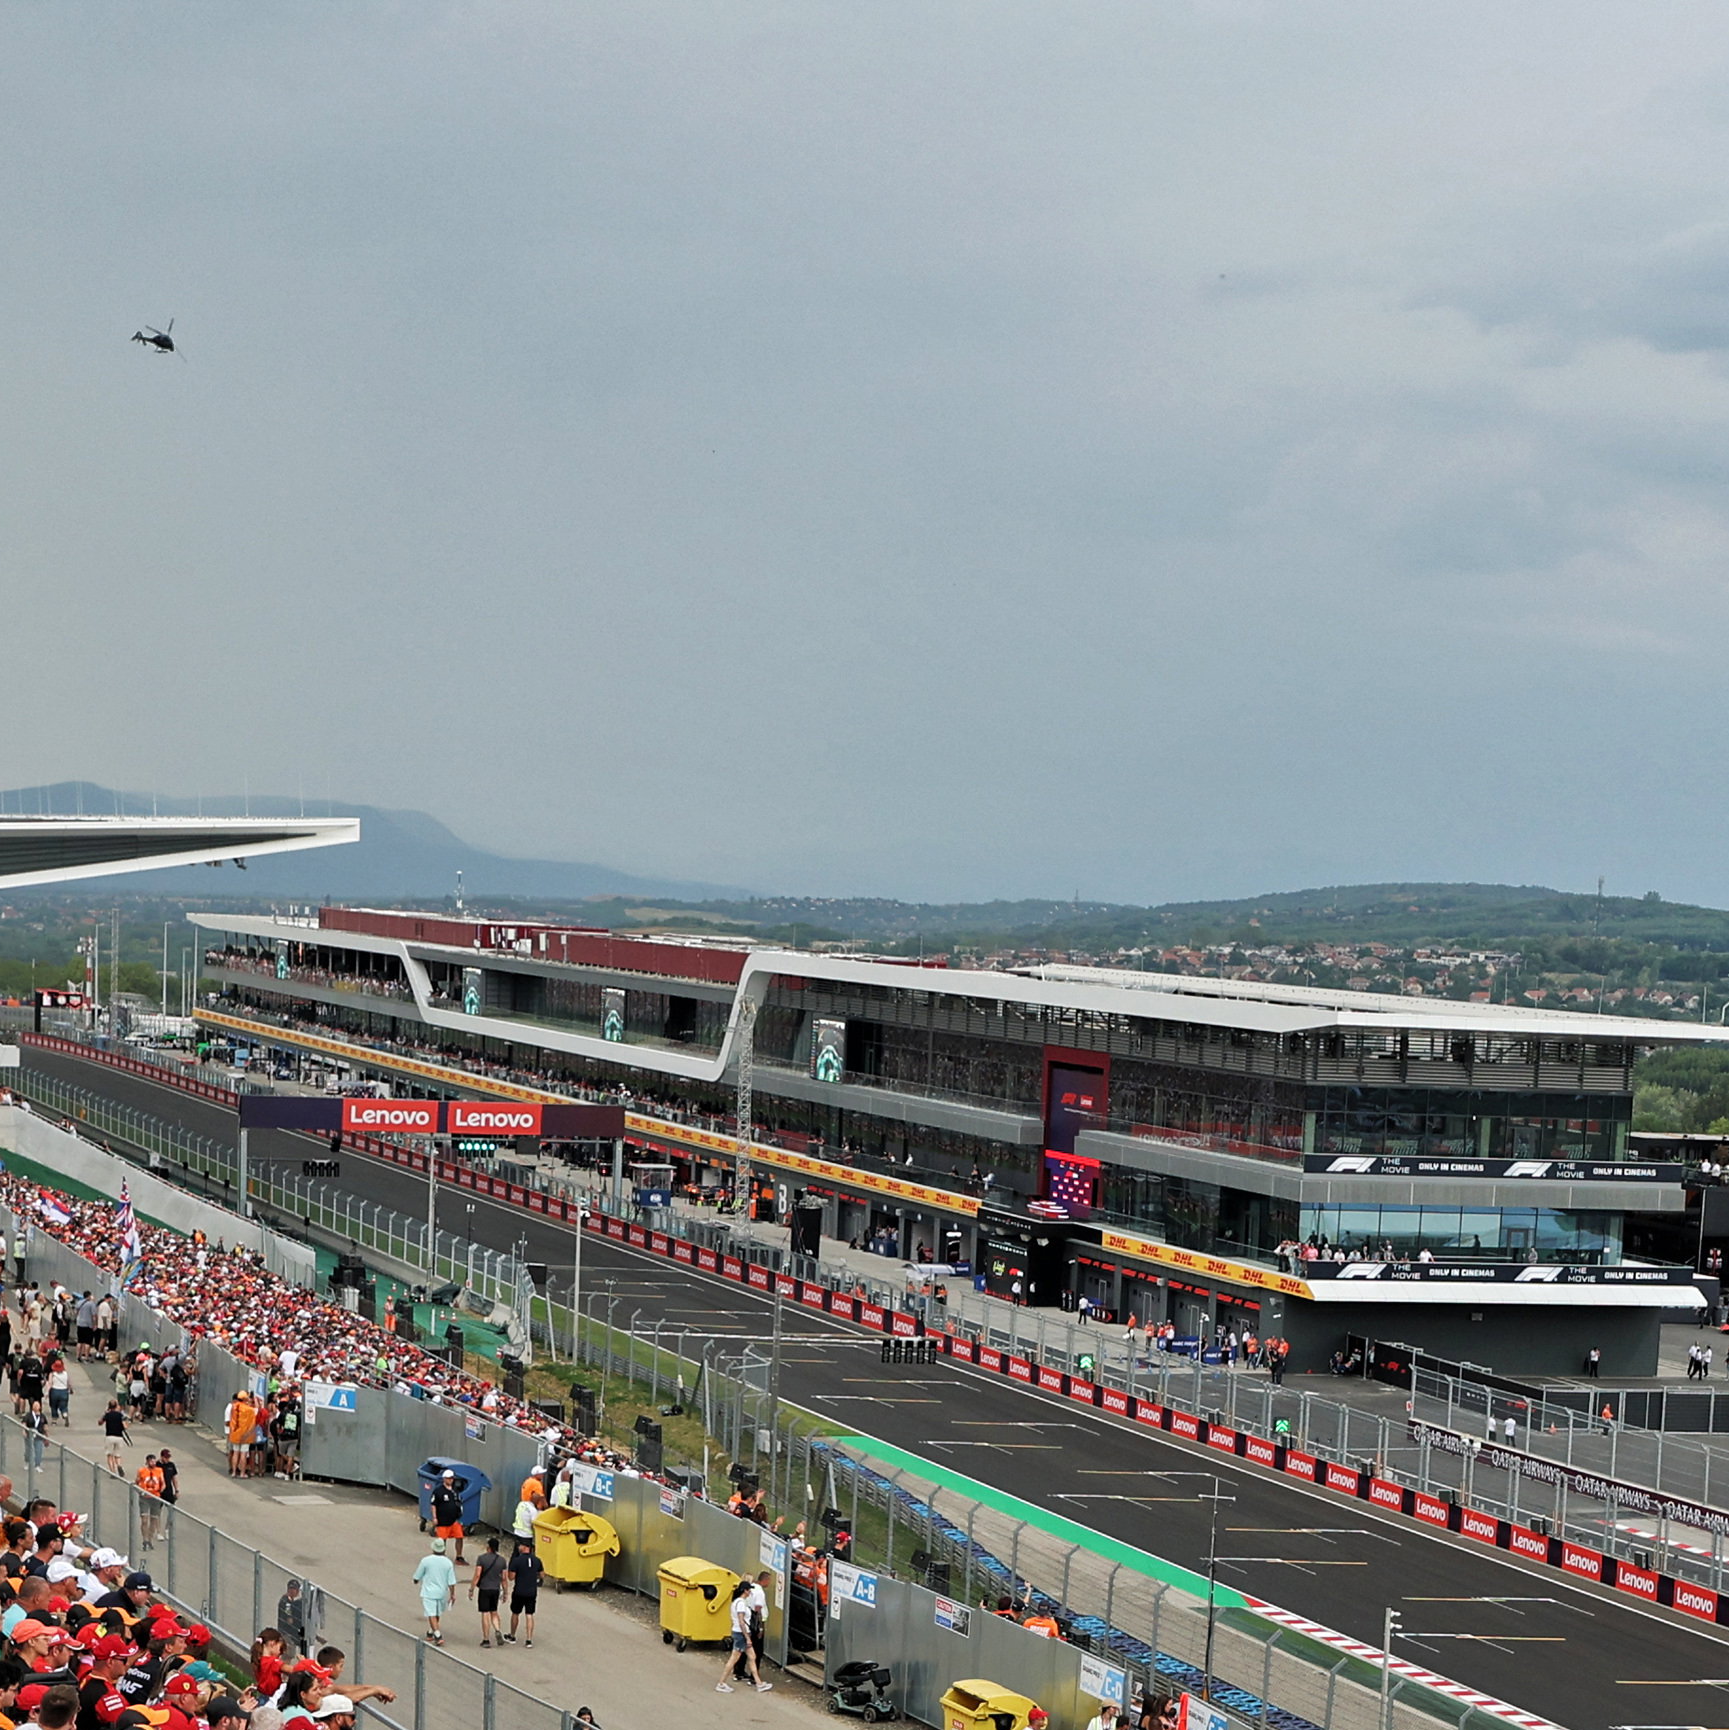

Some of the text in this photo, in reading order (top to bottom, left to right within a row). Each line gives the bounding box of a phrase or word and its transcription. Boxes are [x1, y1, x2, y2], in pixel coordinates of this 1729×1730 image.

[350, 1105, 429, 1127] Lenovo
[455, 1107, 533, 1129] Lenovo
[1381, 1166, 1410, 1174] MOVIE
[1382, 1158, 1401, 1166] THE
[1418, 1163, 1439, 1171] ONLY
[1451, 1164, 1484, 1172] CINEMAS
[1557, 1171, 1584, 1179] MOVIE
[1593, 1167, 1657, 1177] ONLY IN CINEMAS
[630, 1227, 645, 1243] Lenovo
[652, 1235, 667, 1251] Lenovo
[1110, 1236, 1127, 1250] DHL
[675, 1243, 691, 1260] Lenovo
[1141, 1243, 1159, 1257] DHL
[1174, 1252, 1192, 1266] DHL
[699, 1251, 716, 1269] Lenovo
[724, 1260, 741, 1278] Lenovo
[1208, 1260, 1228, 1275] DHL
[1392, 1264, 1412, 1272] THE
[749, 1268, 768, 1287] Lenovo
[1243, 1269, 1264, 1285] DHL
[1391, 1272, 1421, 1280] MOVIE
[1429, 1268, 1495, 1278] ONLY IN CINEMAS
[1568, 1275, 1596, 1283] MOVIE
[1569, 1267, 1587, 1275] THE
[1605, 1272, 1668, 1281] ONLY IN CINEMAS
[1280, 1278, 1302, 1294] DHL
[803, 1287, 822, 1306] Lenovo
[832, 1296, 852, 1315] Lenovo
[862, 1308, 882, 1326] Lenovo
[892, 1317, 914, 1337] Lenovo
[952, 1340, 972, 1358] Lenovo
[981, 1349, 1000, 1368] Lenovo
[1010, 1360, 1029, 1378] Lenovo
[1040, 1371, 1061, 1388] Lenovo
[1071, 1382, 1093, 1400] Lenovo
[1104, 1393, 1126, 1411] Lenovo
[1137, 1403, 1161, 1423] Lenovo
[1173, 1415, 1197, 1435] Lenovo
[1208, 1428, 1234, 1449] Lenovo
[1247, 1441, 1273, 1462] Lenovo
[1287, 1454, 1313, 1476] Lenovo
[1492, 1449, 1560, 1483] QATAR AIRWAYS
[596, 1474, 612, 1496] B-C
[1328, 1468, 1355, 1490] Lenovo
[1371, 1482, 1400, 1506] Lenovo
[1574, 1475, 1650, 1510] QATAR AIRWAYS
[1416, 1502, 1446, 1522] Lenovo
[1464, 1517, 1495, 1539] Lenovo
[1512, 1533, 1546, 1556] Lenovo
[1564, 1550, 1600, 1574] Lenovo
[856, 1580, 876, 1601] A-B
[1618, 1570, 1655, 1595] Lenovo
[1676, 1589, 1714, 1615] Lenovo
[1106, 1675, 1122, 1700] C-D
